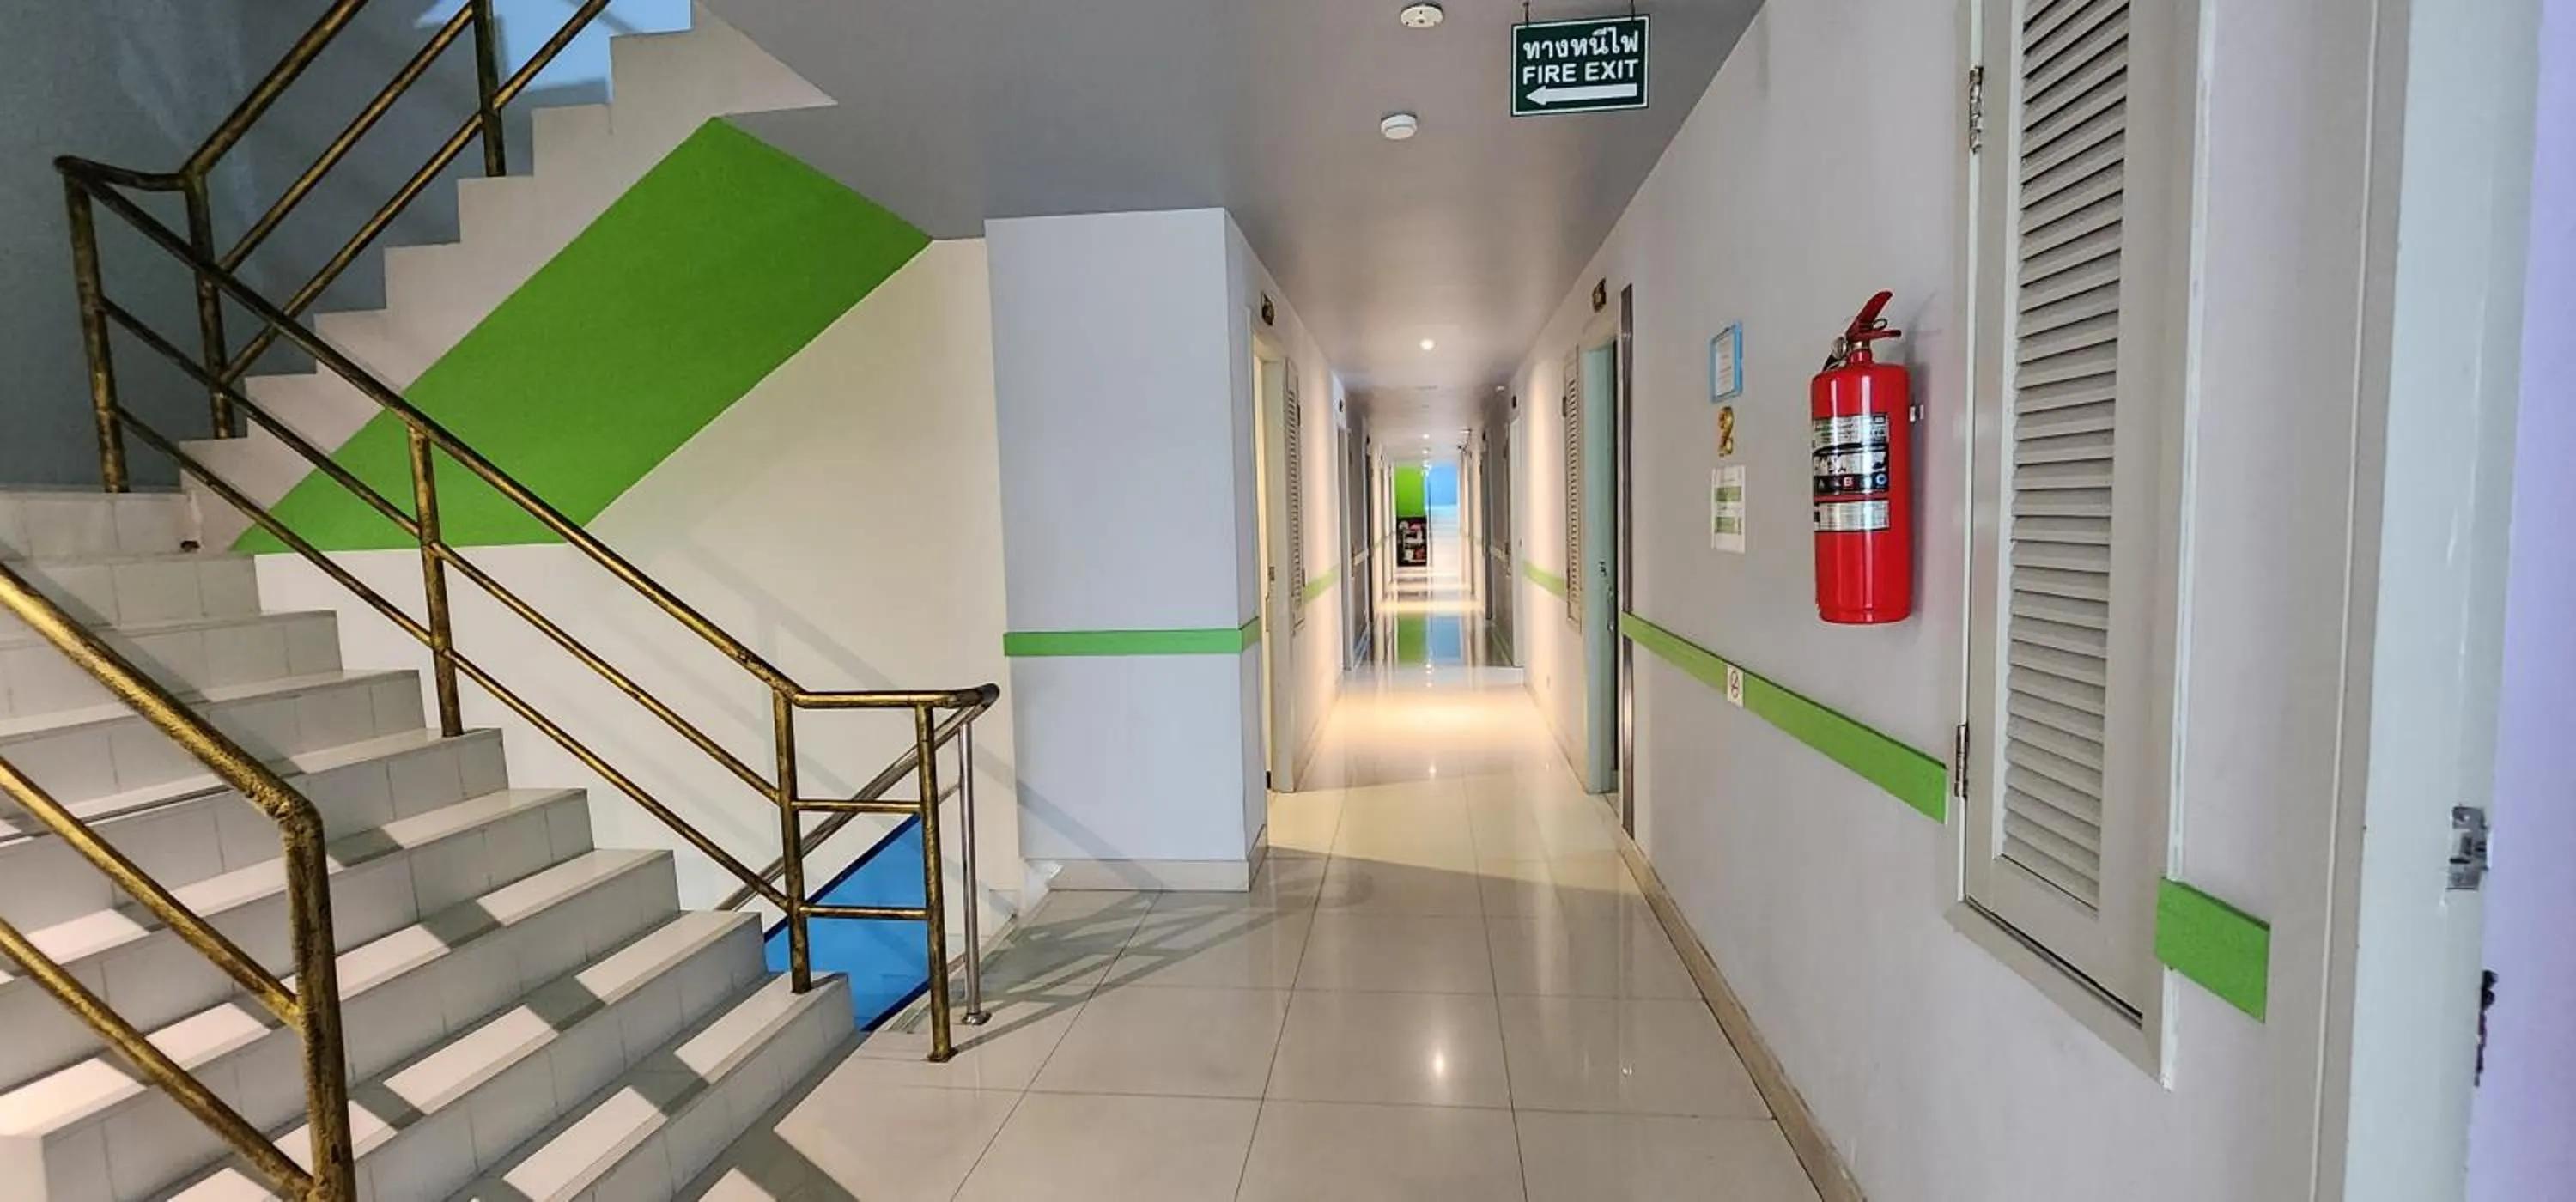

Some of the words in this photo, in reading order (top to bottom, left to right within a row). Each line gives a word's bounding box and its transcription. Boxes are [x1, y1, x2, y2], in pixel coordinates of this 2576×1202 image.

[1522, 26, 1639, 59] ทางหนีไฟ
[1522, 63, 1577, 85] FIRE
[1584, 58, 1639, 82] EXIT
[1844, 477, 1853, 487] B
